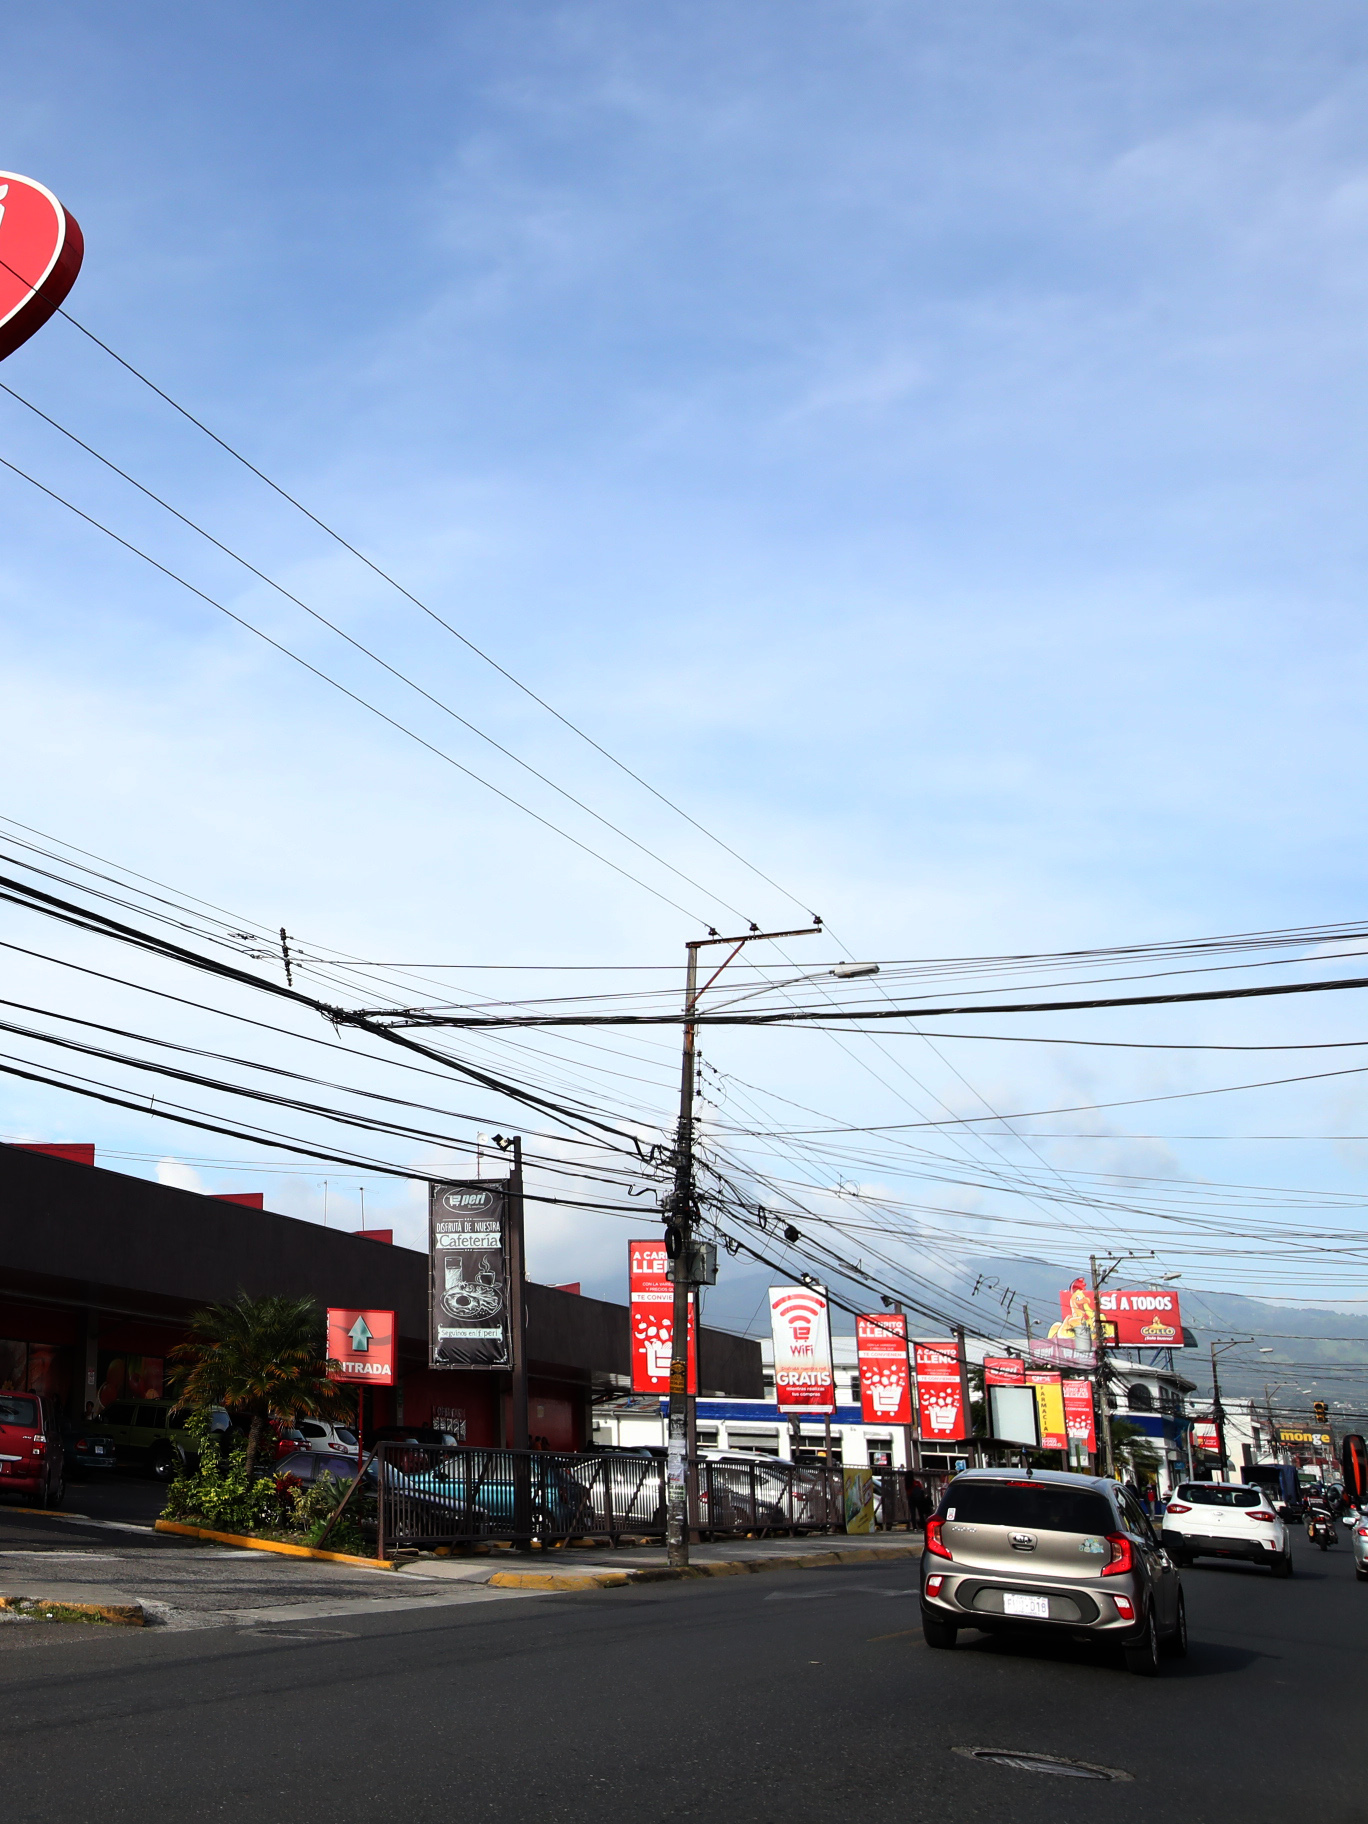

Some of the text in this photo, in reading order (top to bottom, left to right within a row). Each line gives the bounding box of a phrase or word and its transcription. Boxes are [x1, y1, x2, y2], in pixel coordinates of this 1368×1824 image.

[461, 1192, 487, 1206] peri
[464, 1222, 472, 1232] DE
[474, 1221, 501, 1232] NUESTRA
[439, 1234, 499, 1247] Cafetería
[633, 1251, 641, 1259] A
[1100, 1293, 1173, 1310] SÍ A TODOS
[1142, 1327, 1174, 1335] GOLLO
[790, 1345, 814, 1356] WiFi
[341, 1362, 392, 1375] TRADA
[777, 1371, 831, 1386] GRATIS
[1040, 1386, 1049, 1431] FARMACIA
[1280, 1432, 1331, 1445] monge
